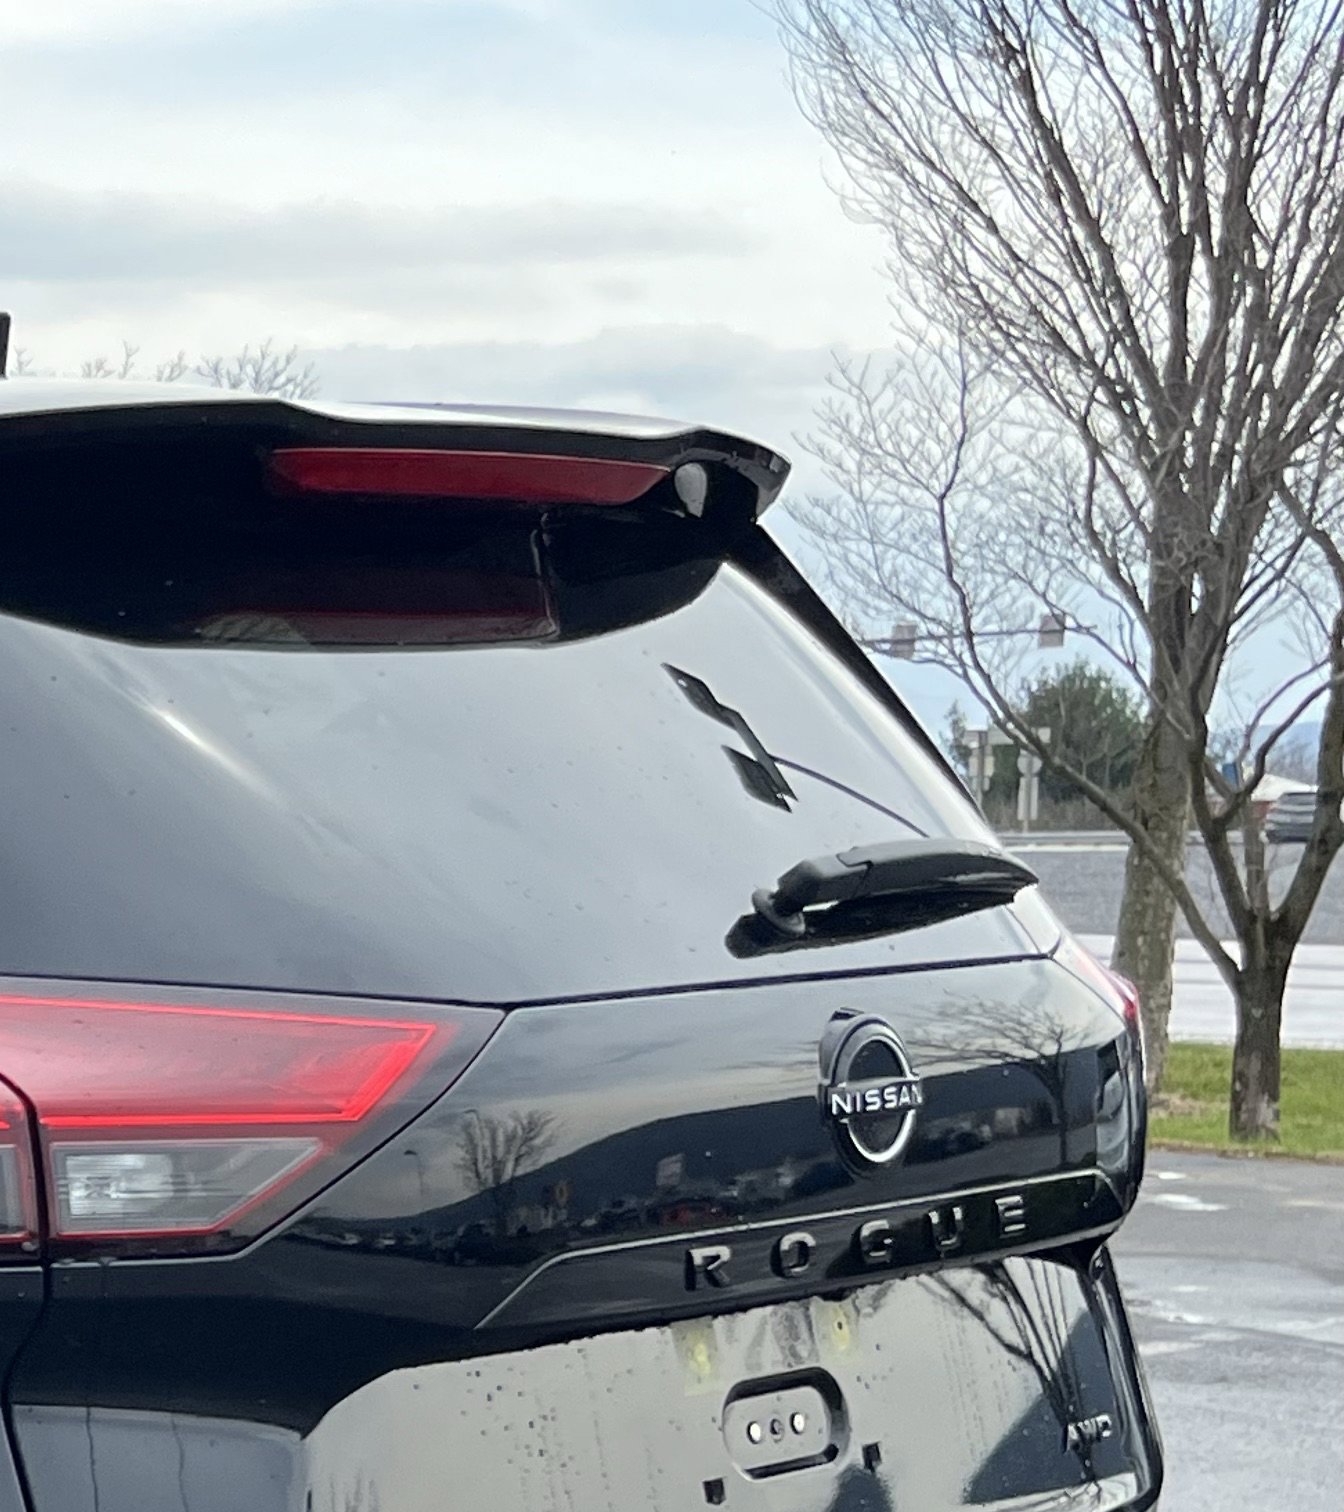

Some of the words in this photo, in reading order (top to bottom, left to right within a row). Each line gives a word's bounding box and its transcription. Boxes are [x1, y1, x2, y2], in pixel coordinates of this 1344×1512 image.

[831, 1084, 923, 1115] NISSAN
[685, 1194, 1027, 1291] ROGUE
[1064, 1413, 1112, 1453] AWD
